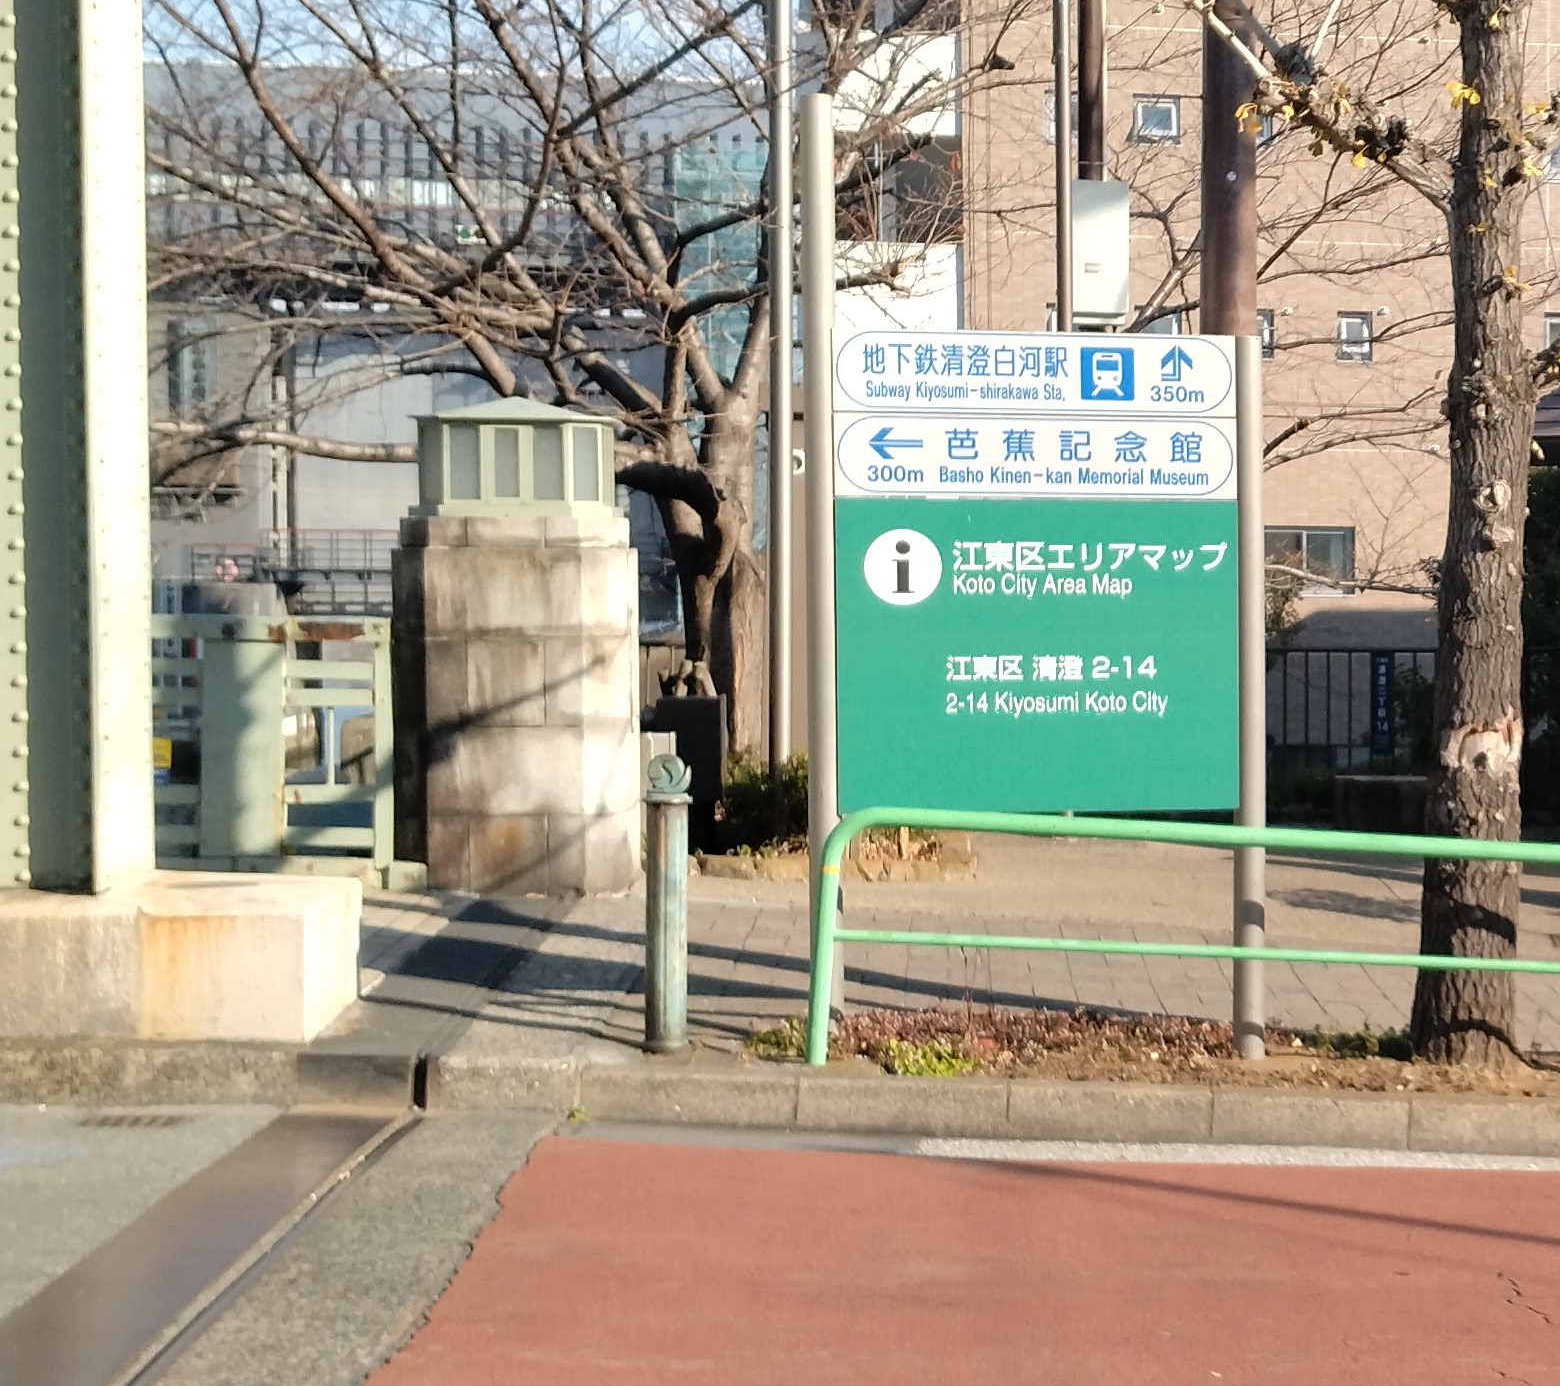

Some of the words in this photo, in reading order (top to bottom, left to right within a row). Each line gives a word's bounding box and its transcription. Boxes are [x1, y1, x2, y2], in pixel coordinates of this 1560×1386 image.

[862, 343, 1069, 378] 地下鉄清澄白河駅
[865, 379, 911, 402] Subway
[1150, 385, 1205, 403] 350m
[867, 464, 925, 483] 300m
[939, 465, 984, 483] Basho
[990, 465, 1072, 485] Kinen-kan
[1078, 466, 1144, 486] Memorial
[1149, 468, 1210, 487] Museum
[952, 540, 1229, 572] 江東区エリアマップ
[952, 573, 996, 594] Koto
[1001, 573, 1037, 599] City
[1042, 575, 1087, 594] Area
[1092, 576, 1133, 598] Map
[945, 655, 1024, 682] 江東区
[1092, 655, 1158, 680] 2-14
[945, 692, 989, 714] 2-14
[994, 690, 1079, 718] Kiyosumi
[1084, 690, 1127, 713] Koto
[1132, 690, 1168, 717] City
